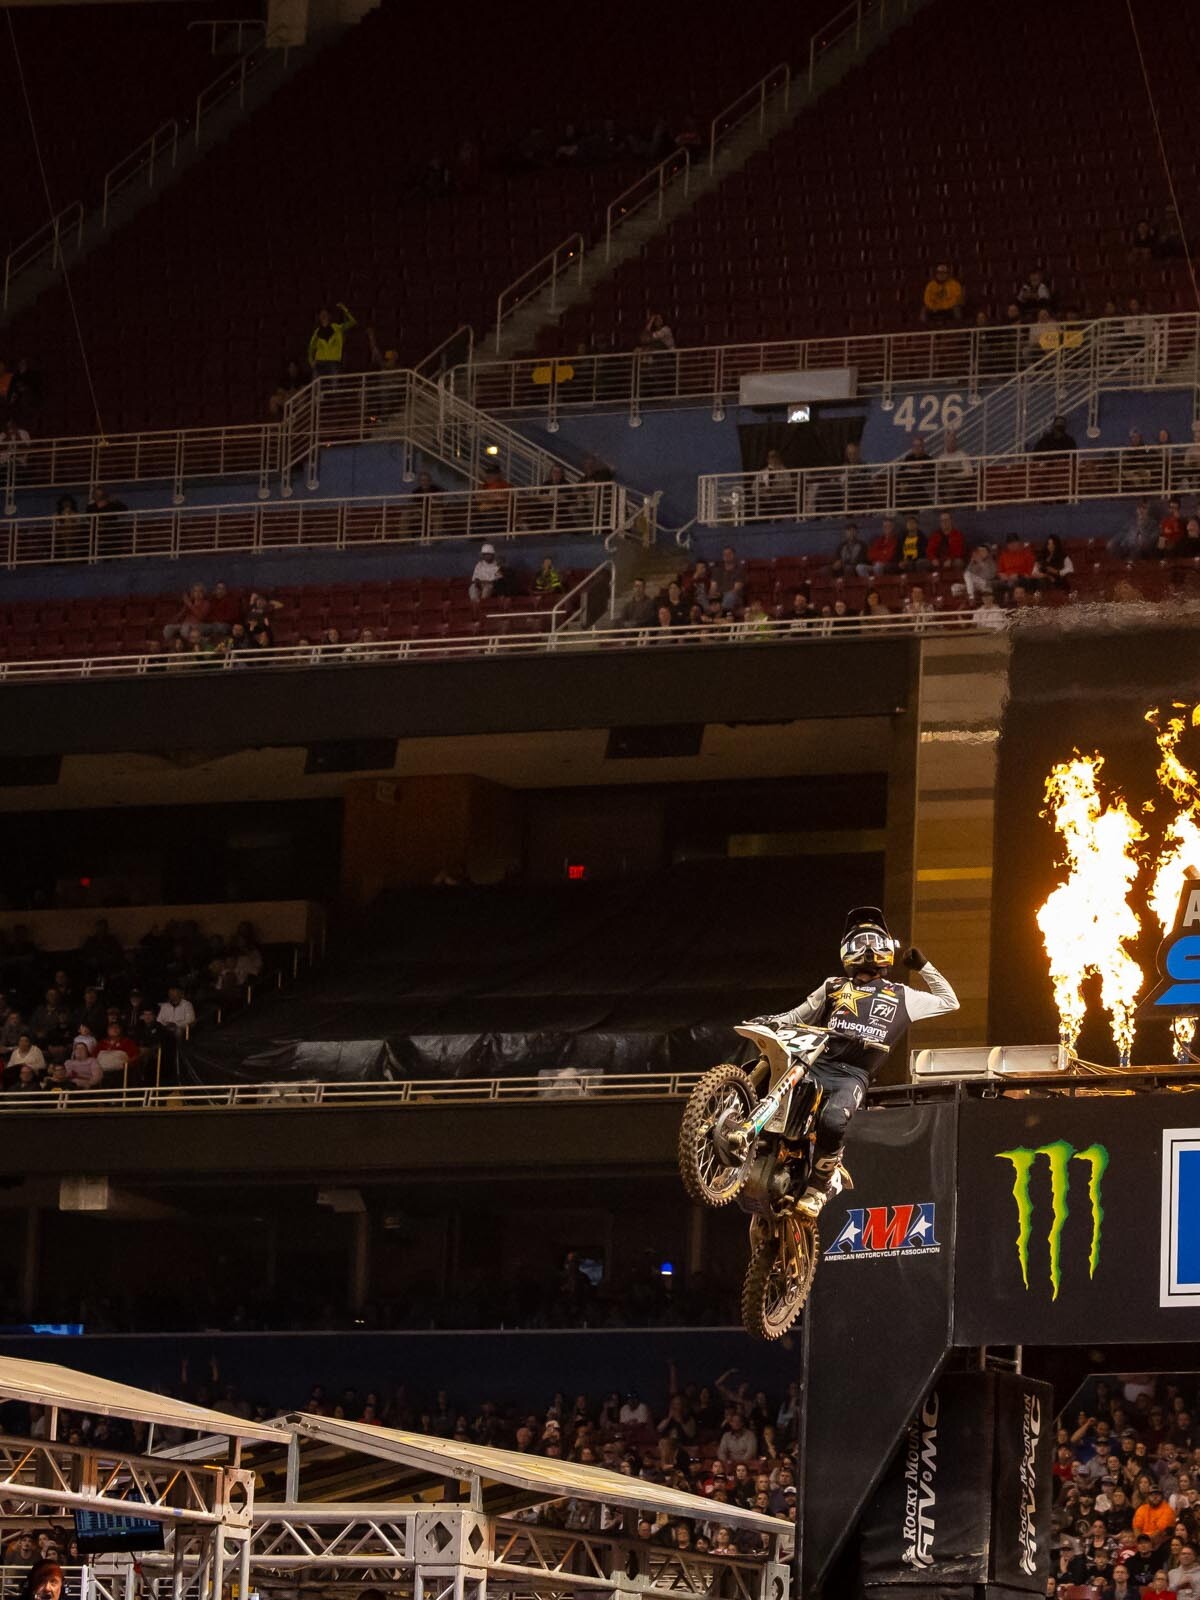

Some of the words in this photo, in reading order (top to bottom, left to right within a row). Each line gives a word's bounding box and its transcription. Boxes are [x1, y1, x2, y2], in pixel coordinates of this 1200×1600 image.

[893, 393, 963, 432] 426
[872, 1003, 894, 1018] FLY
[823, 1203, 941, 1254] AMA
[824, 1254, 855, 1262] AMERICAN
[856, 1250, 900, 1260] MOTORCYCLIST
[900, 1247, 940, 1256] ASSOCIATION
[1020, 1394, 1032, 1486] MOUNTAIN
[903, 1485, 918, 1542] ROCKY
[1018, 1489, 1029, 1546] ROCKY
